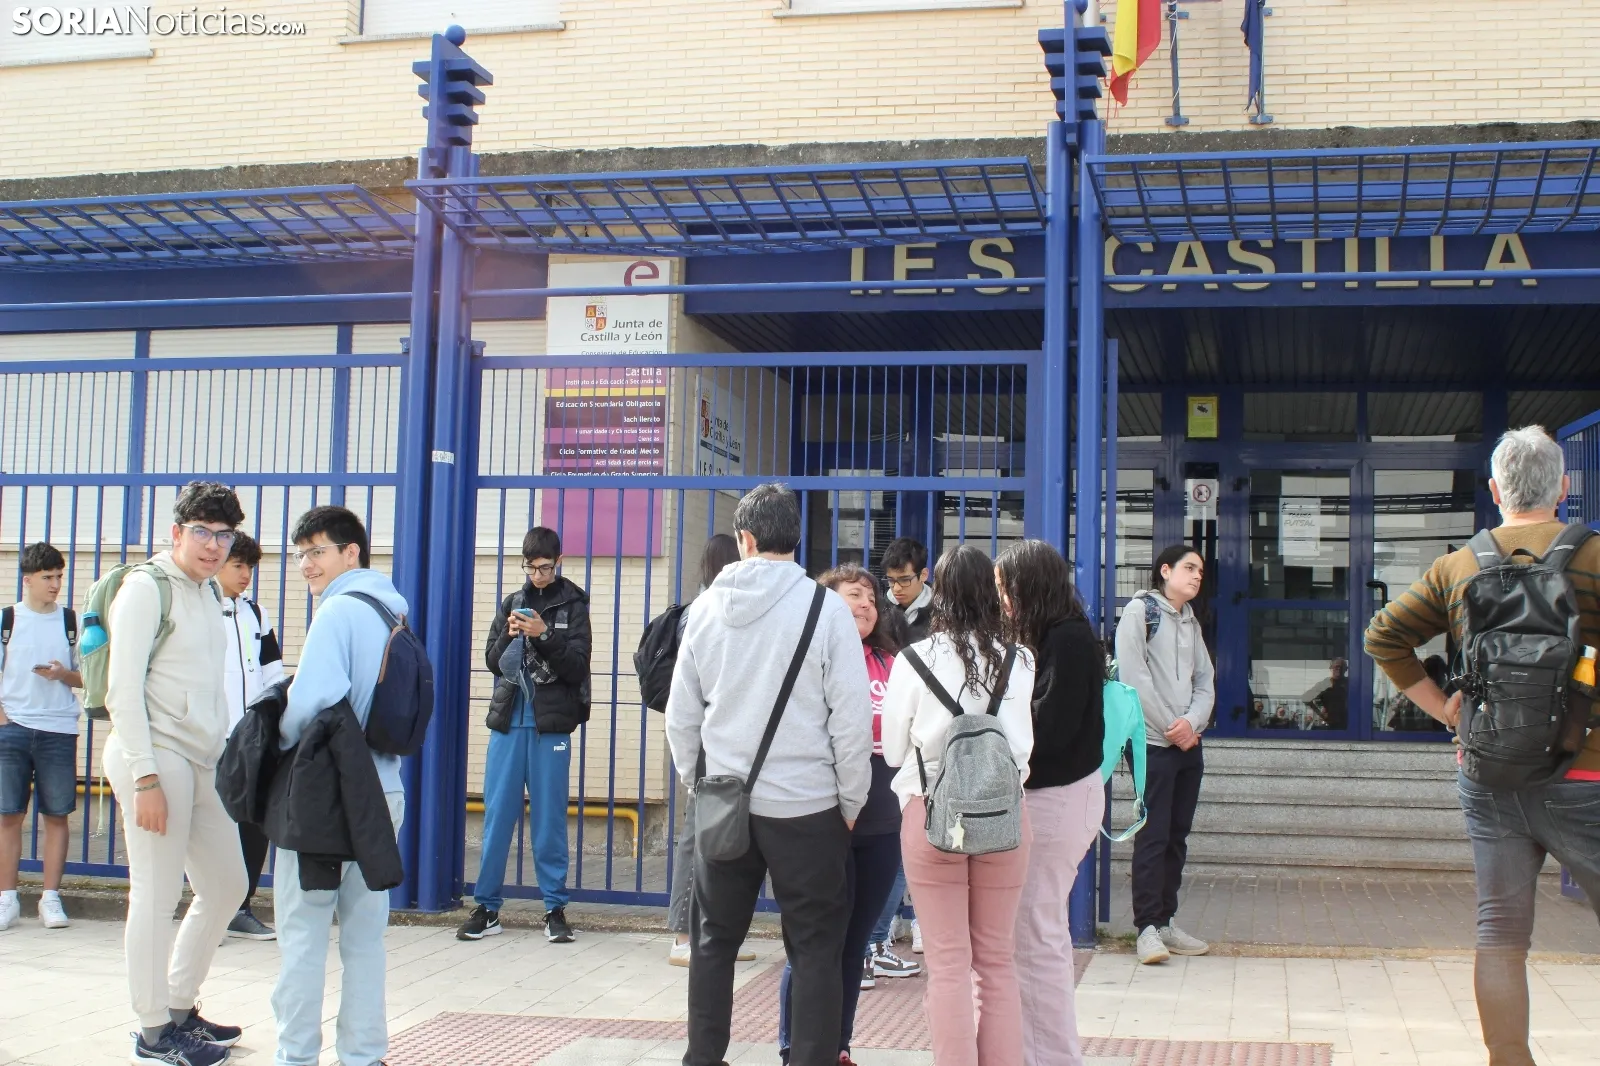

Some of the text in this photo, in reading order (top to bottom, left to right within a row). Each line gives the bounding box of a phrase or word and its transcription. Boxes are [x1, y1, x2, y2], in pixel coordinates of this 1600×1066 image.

[850, 234, 1538, 295] I.E.S. CASTILLA
[612, 319, 663, 329] Junta de
[580, 331, 663, 343] Castilla y León
